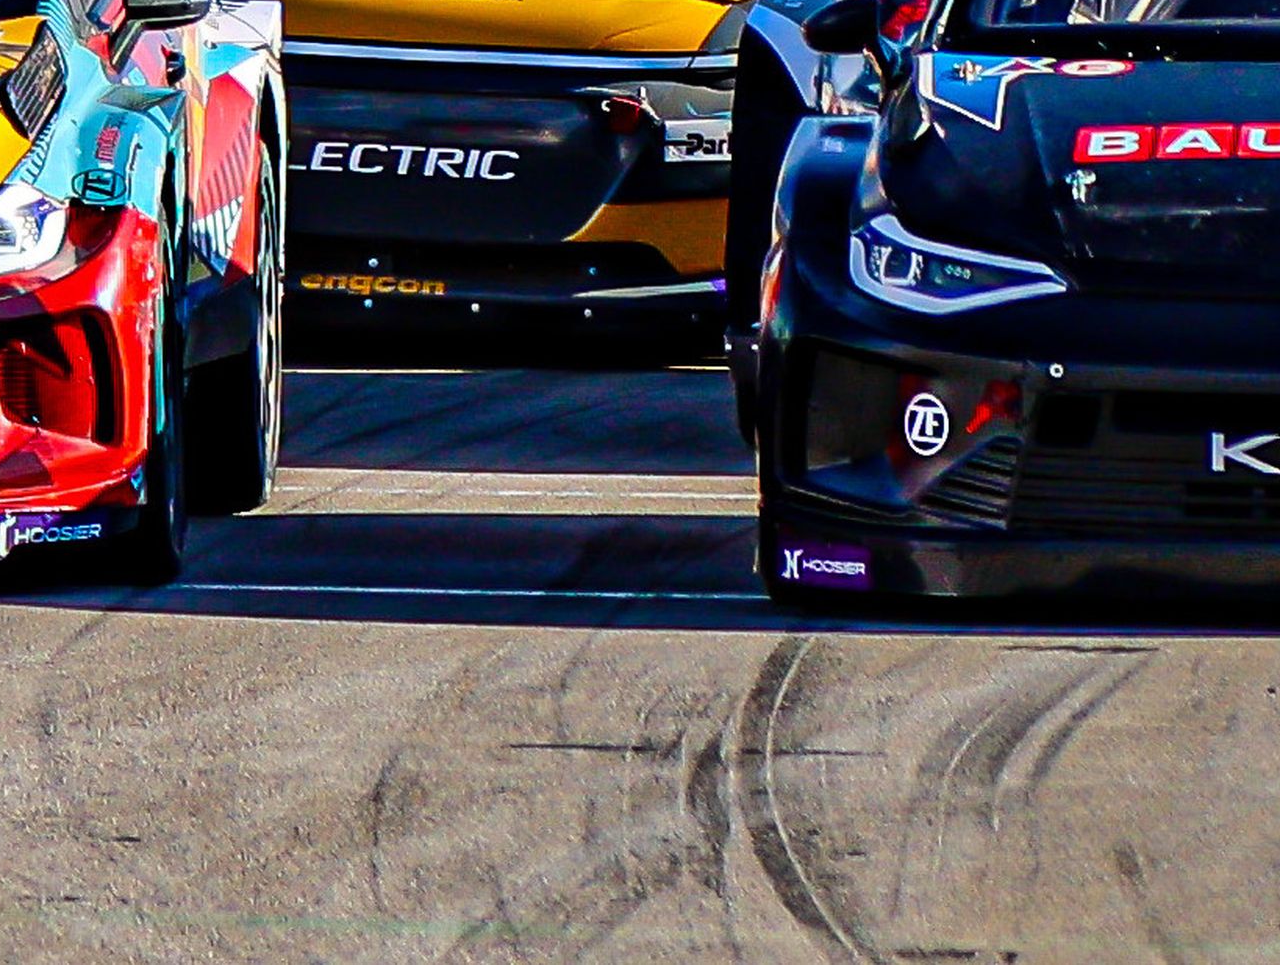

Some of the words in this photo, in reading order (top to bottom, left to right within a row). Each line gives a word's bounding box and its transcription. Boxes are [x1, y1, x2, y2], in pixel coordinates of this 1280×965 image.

[686, 133, 732, 156] Par
[300, 273, 445, 296] engcon
[13, 523, 102, 546] HOOSIER
[803, 559, 865, 575] HOOSIER
